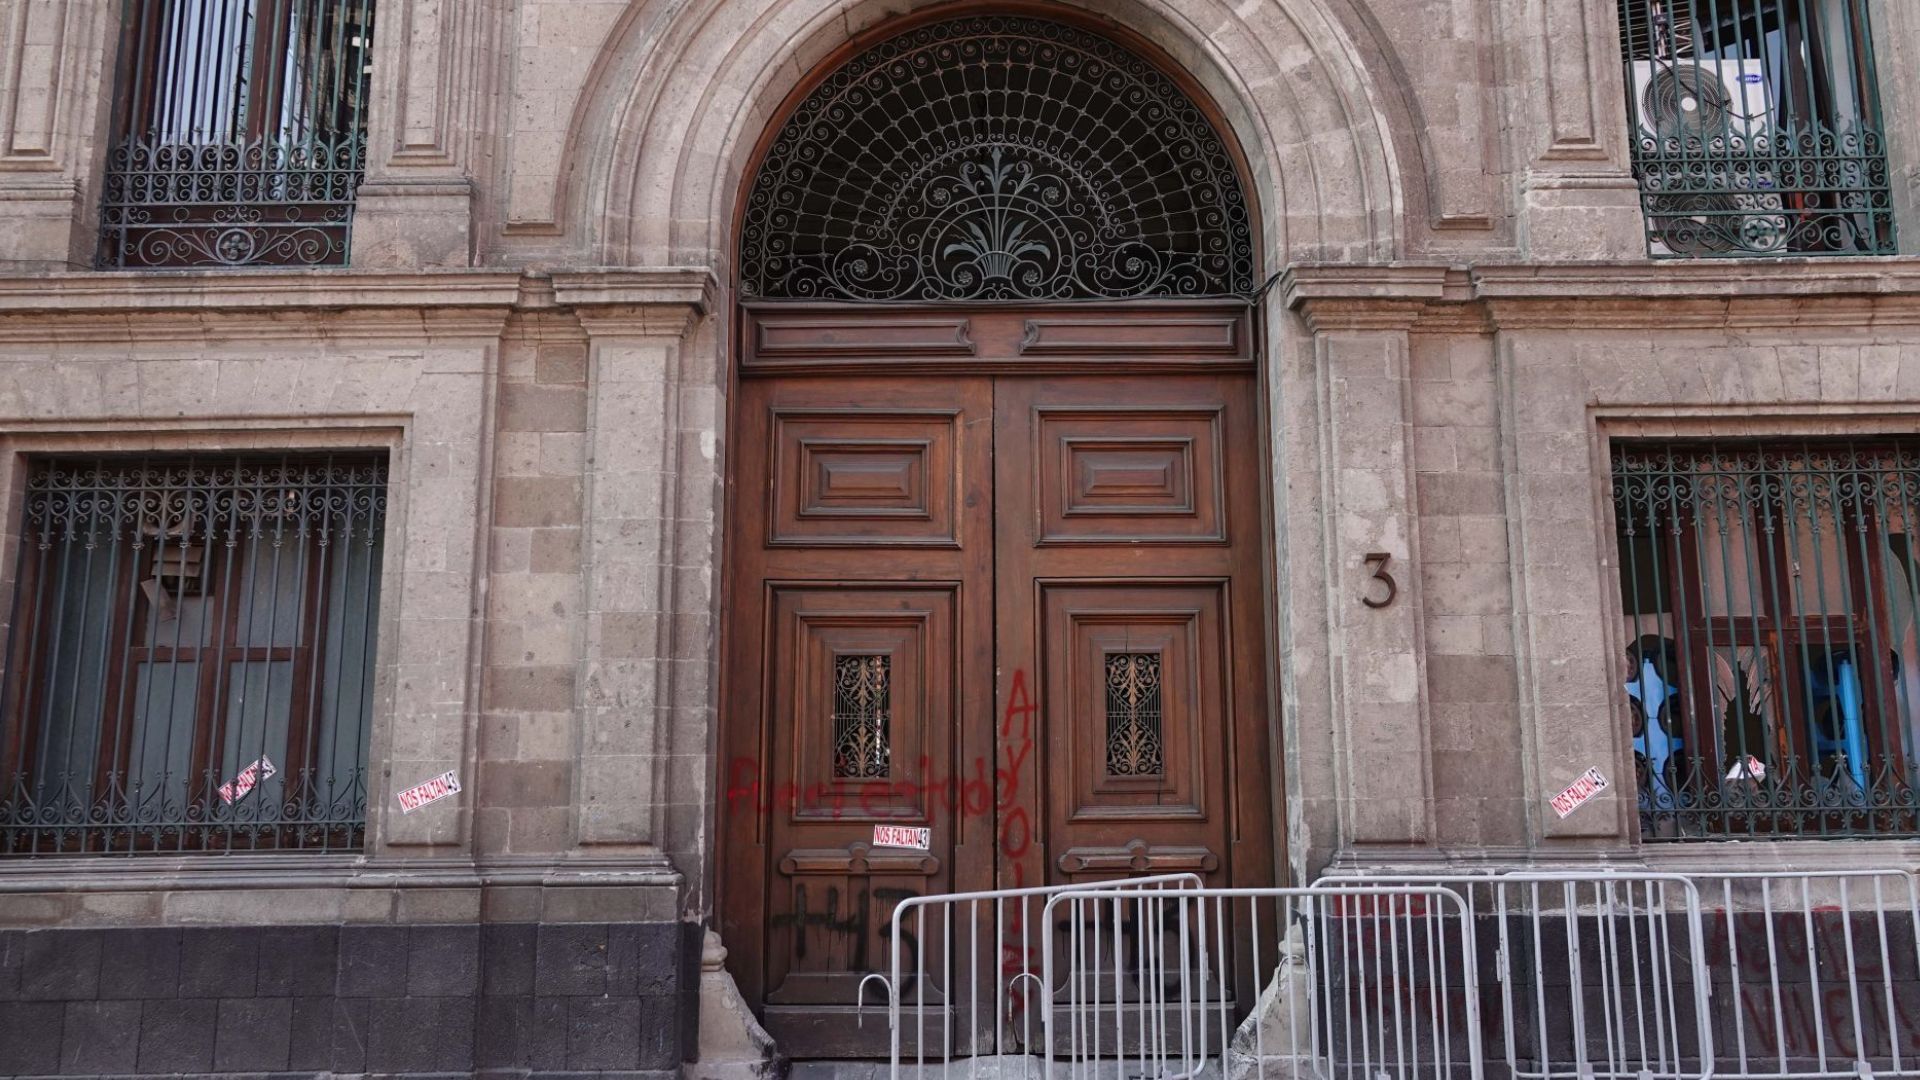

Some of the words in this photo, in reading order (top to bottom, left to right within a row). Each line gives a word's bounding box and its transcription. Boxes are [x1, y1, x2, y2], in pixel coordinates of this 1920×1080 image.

[1362, 552, 1397, 609] 3
[220, 782, 240, 802] NO
[400, 789, 419, 811] NOS
[417, 777, 449, 804] FALTAN
[1551, 794, 1573, 815] NOS
[1566, 777, 1598, 805] FALTAN
[875, 826, 890, 845] NOS
[891, 828, 918, 846] FALTAN
